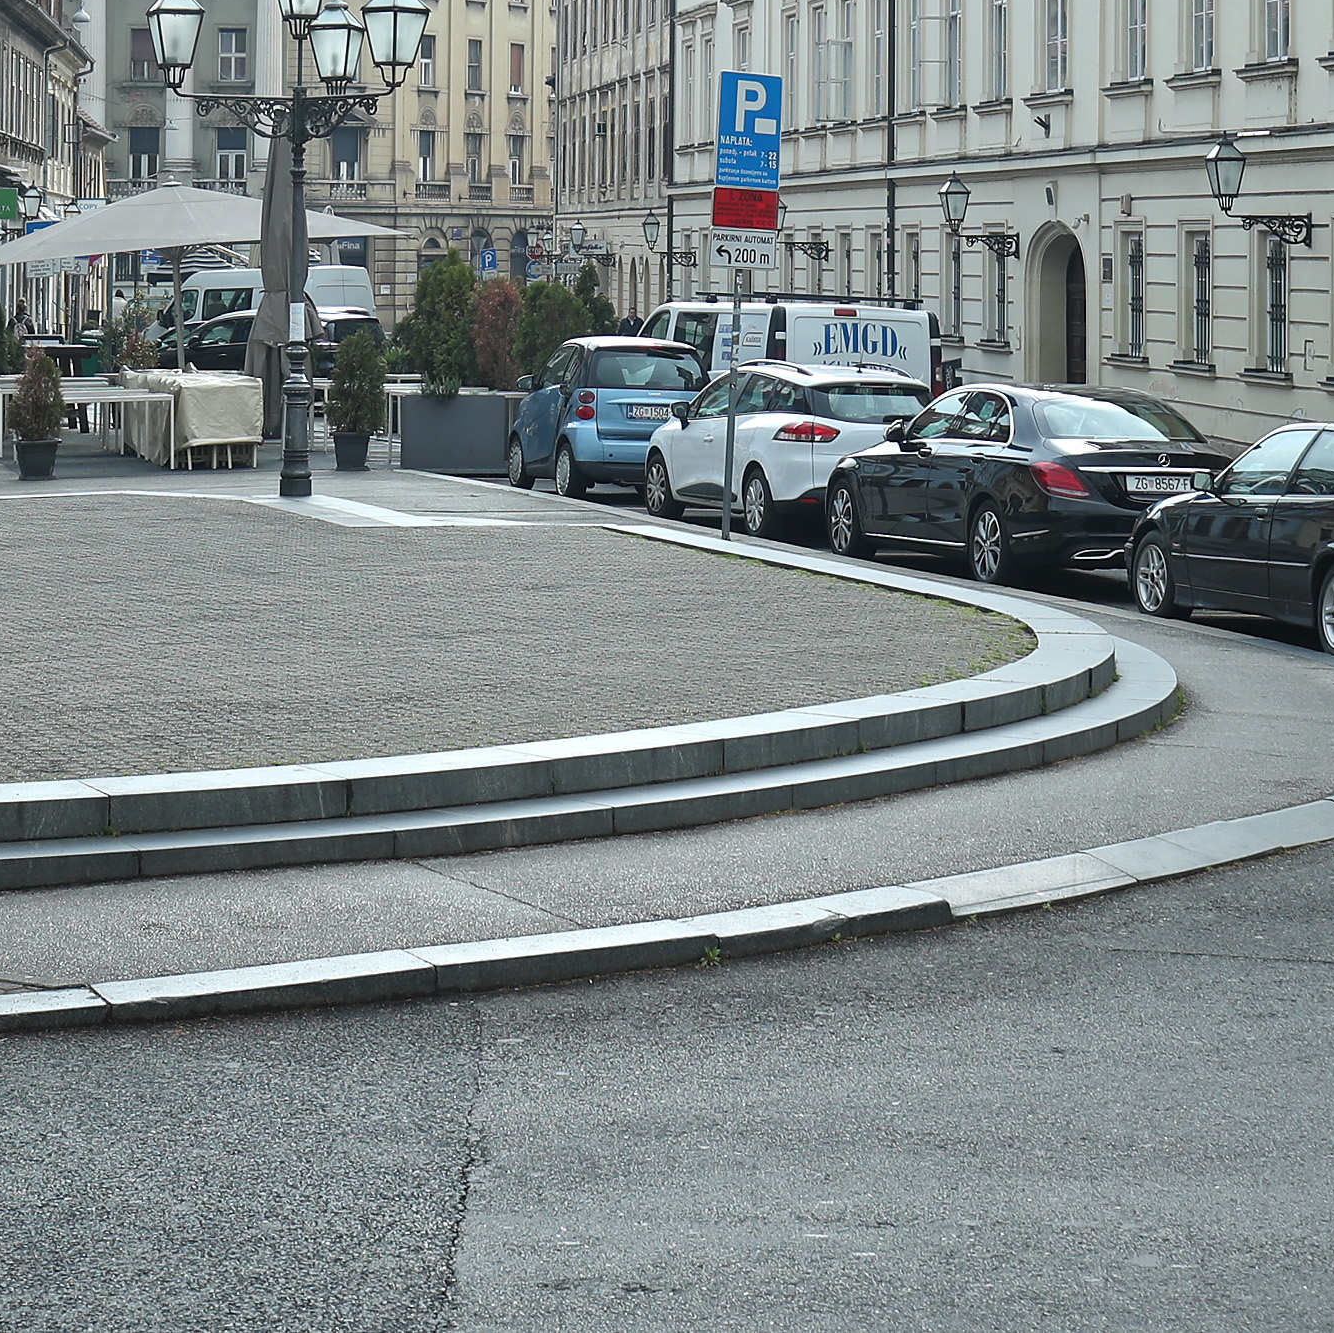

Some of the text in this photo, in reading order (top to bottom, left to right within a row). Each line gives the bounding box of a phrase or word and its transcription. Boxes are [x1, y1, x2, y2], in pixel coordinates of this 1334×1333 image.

[735, 79, 767, 132] P
[720, 134, 753, 146] NAPLATA:
[712, 233, 774, 245] PARKIRNI AUTOMAT
[734, 248, 769, 264] 200 m
[634, 407, 644, 416] ZG
[1134, 477, 1193, 490] ZG 8567-F
